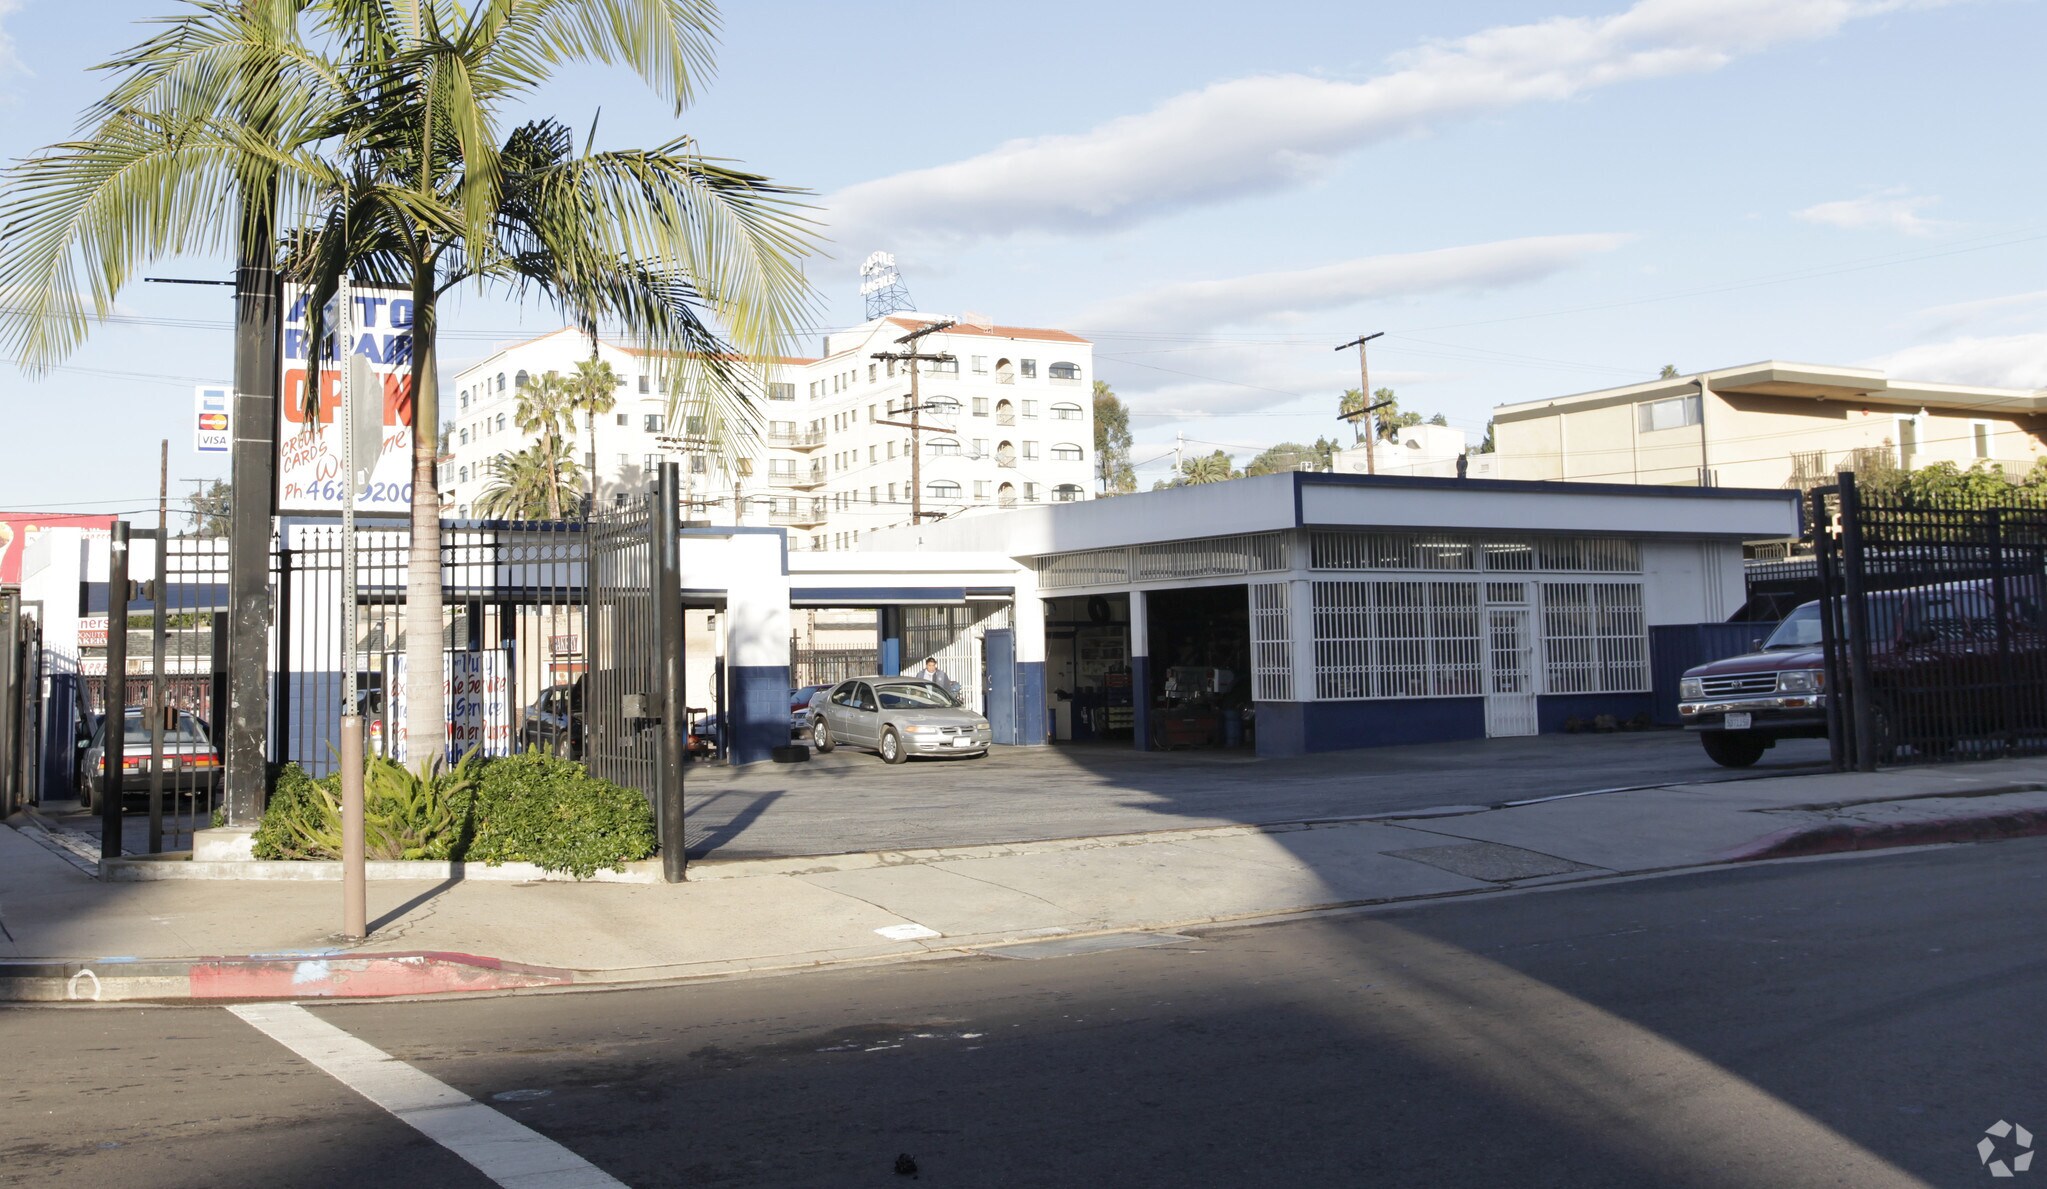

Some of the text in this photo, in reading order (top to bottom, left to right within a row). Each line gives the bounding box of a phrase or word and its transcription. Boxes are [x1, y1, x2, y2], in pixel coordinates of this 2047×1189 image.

[285, 293, 413, 329] ATO
[285, 328, 413, 366] RPAIR
[284, 368, 412, 427] OPN
[203, 435, 226, 444] VISA
[284, 441, 328, 473] CARDS
[80, 619, 108, 629] ners
[78, 637, 108, 645] AKERY
